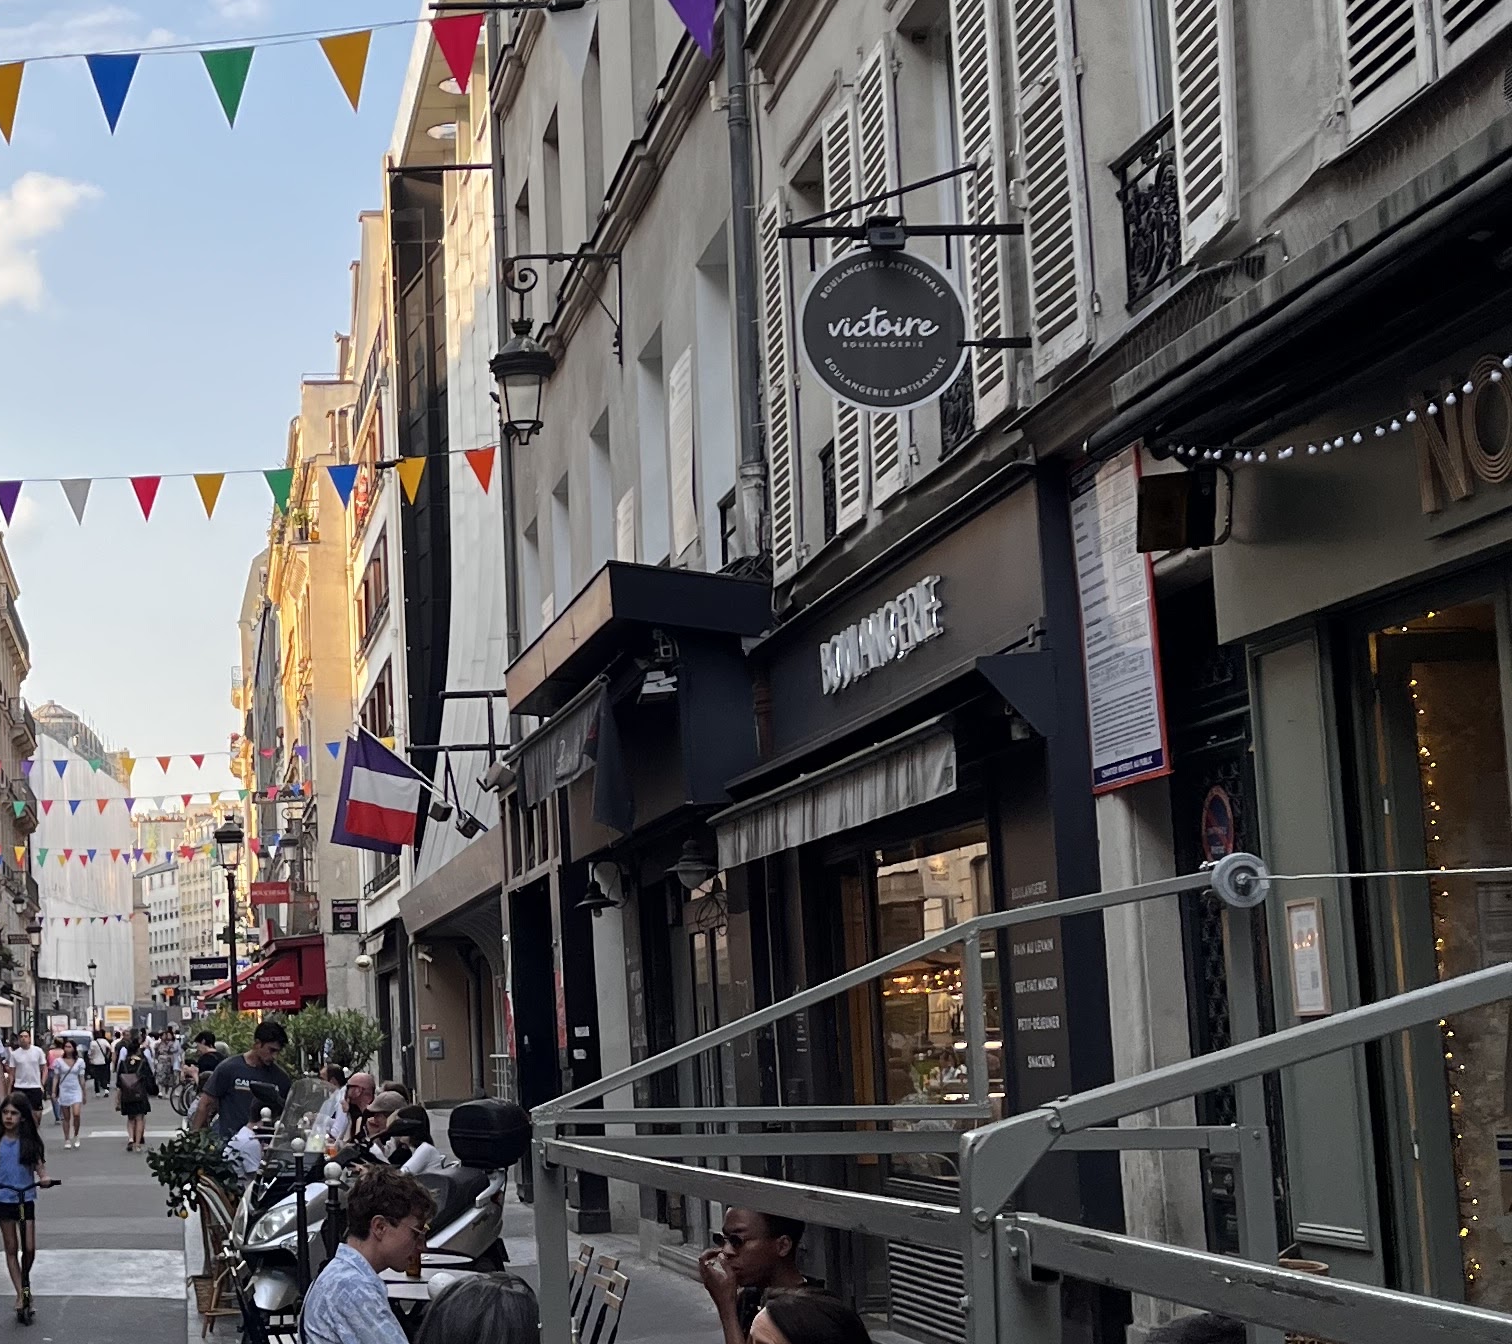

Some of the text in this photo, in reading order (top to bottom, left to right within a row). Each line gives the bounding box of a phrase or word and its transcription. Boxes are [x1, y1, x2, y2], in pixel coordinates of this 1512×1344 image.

[820, 260, 946, 299] BOULANGERIE ARTISANALE
[828, 306, 939, 338] victoire
[824, 356, 947, 397] BOULANGERIE ARTISANALE
[819, 575, 944, 695] BOULANGERIE
[1014, 942, 1026, 956] PAIN
[1026, 941, 1034, 954] AU
[1027, 1053, 1055, 1069] SNACKING
